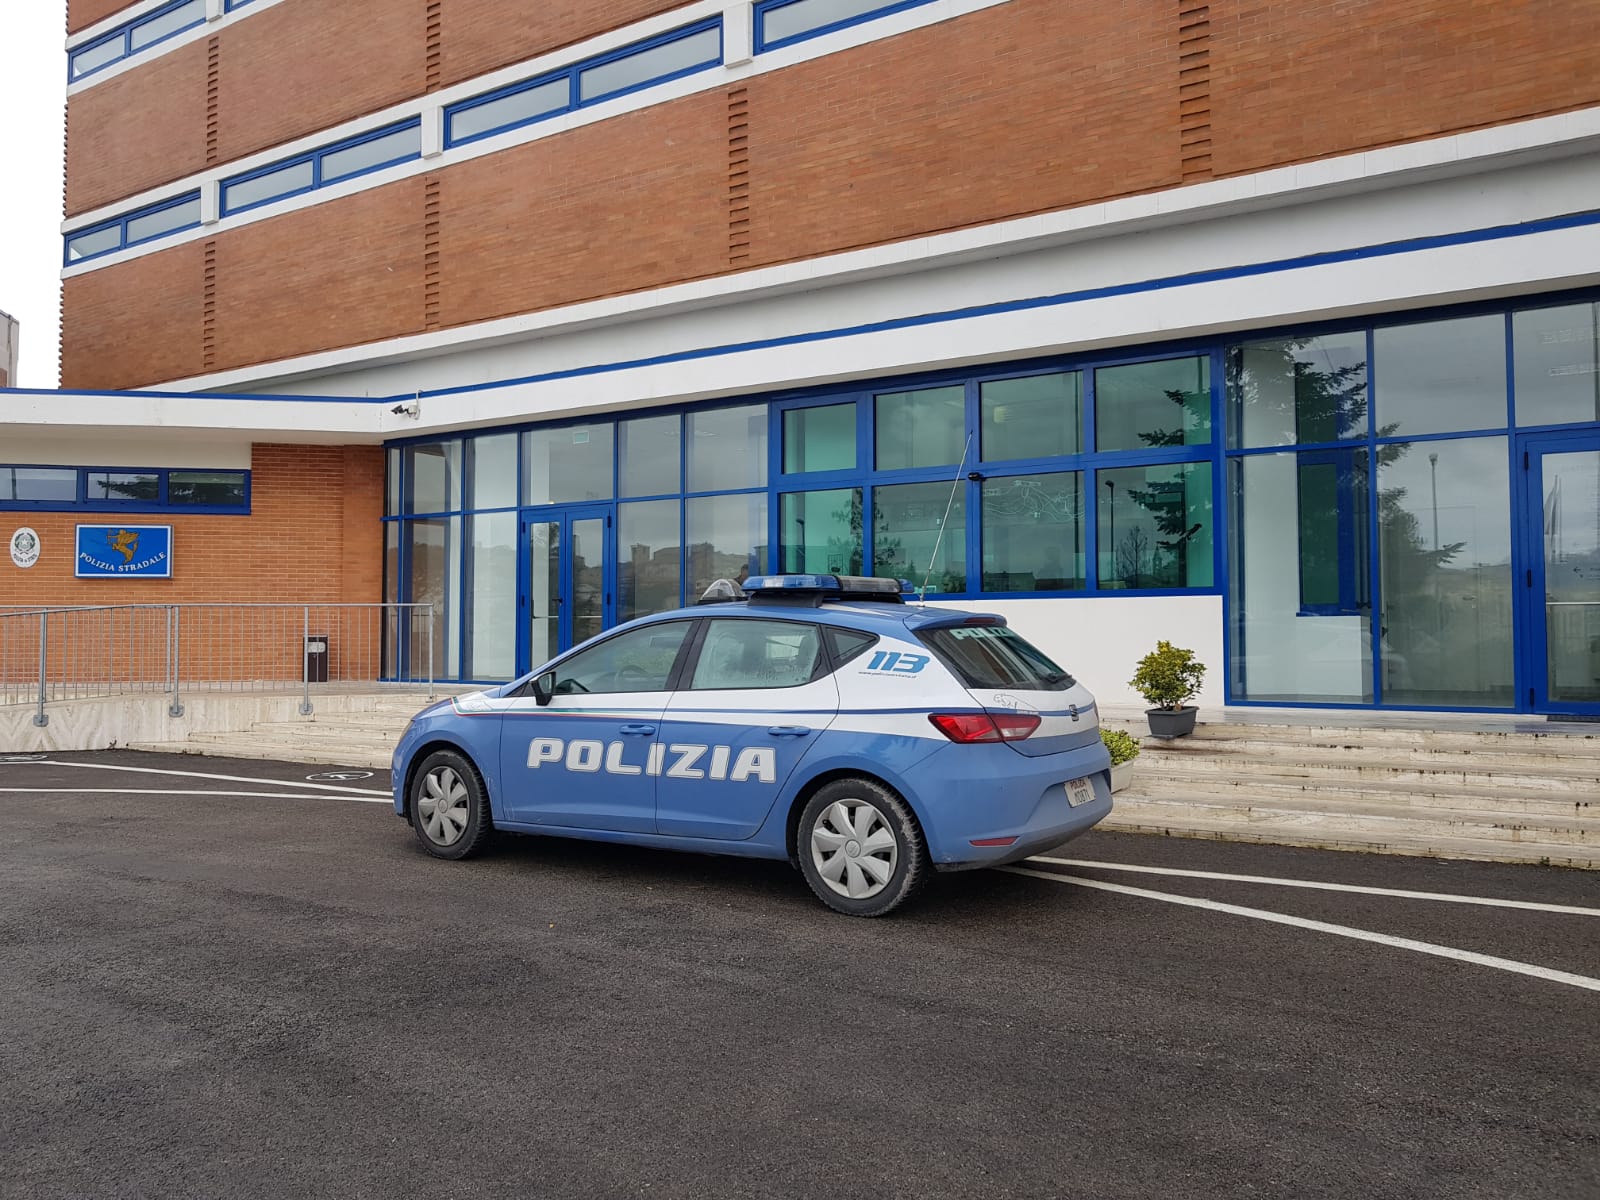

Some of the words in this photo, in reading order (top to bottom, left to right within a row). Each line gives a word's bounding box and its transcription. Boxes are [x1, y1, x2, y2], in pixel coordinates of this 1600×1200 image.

[80, 552, 115, 571] POLIZIA
[118, 551, 167, 572] STRADALE
[867, 651, 930, 673] 113
[526, 737, 777, 784] POLIZIA
